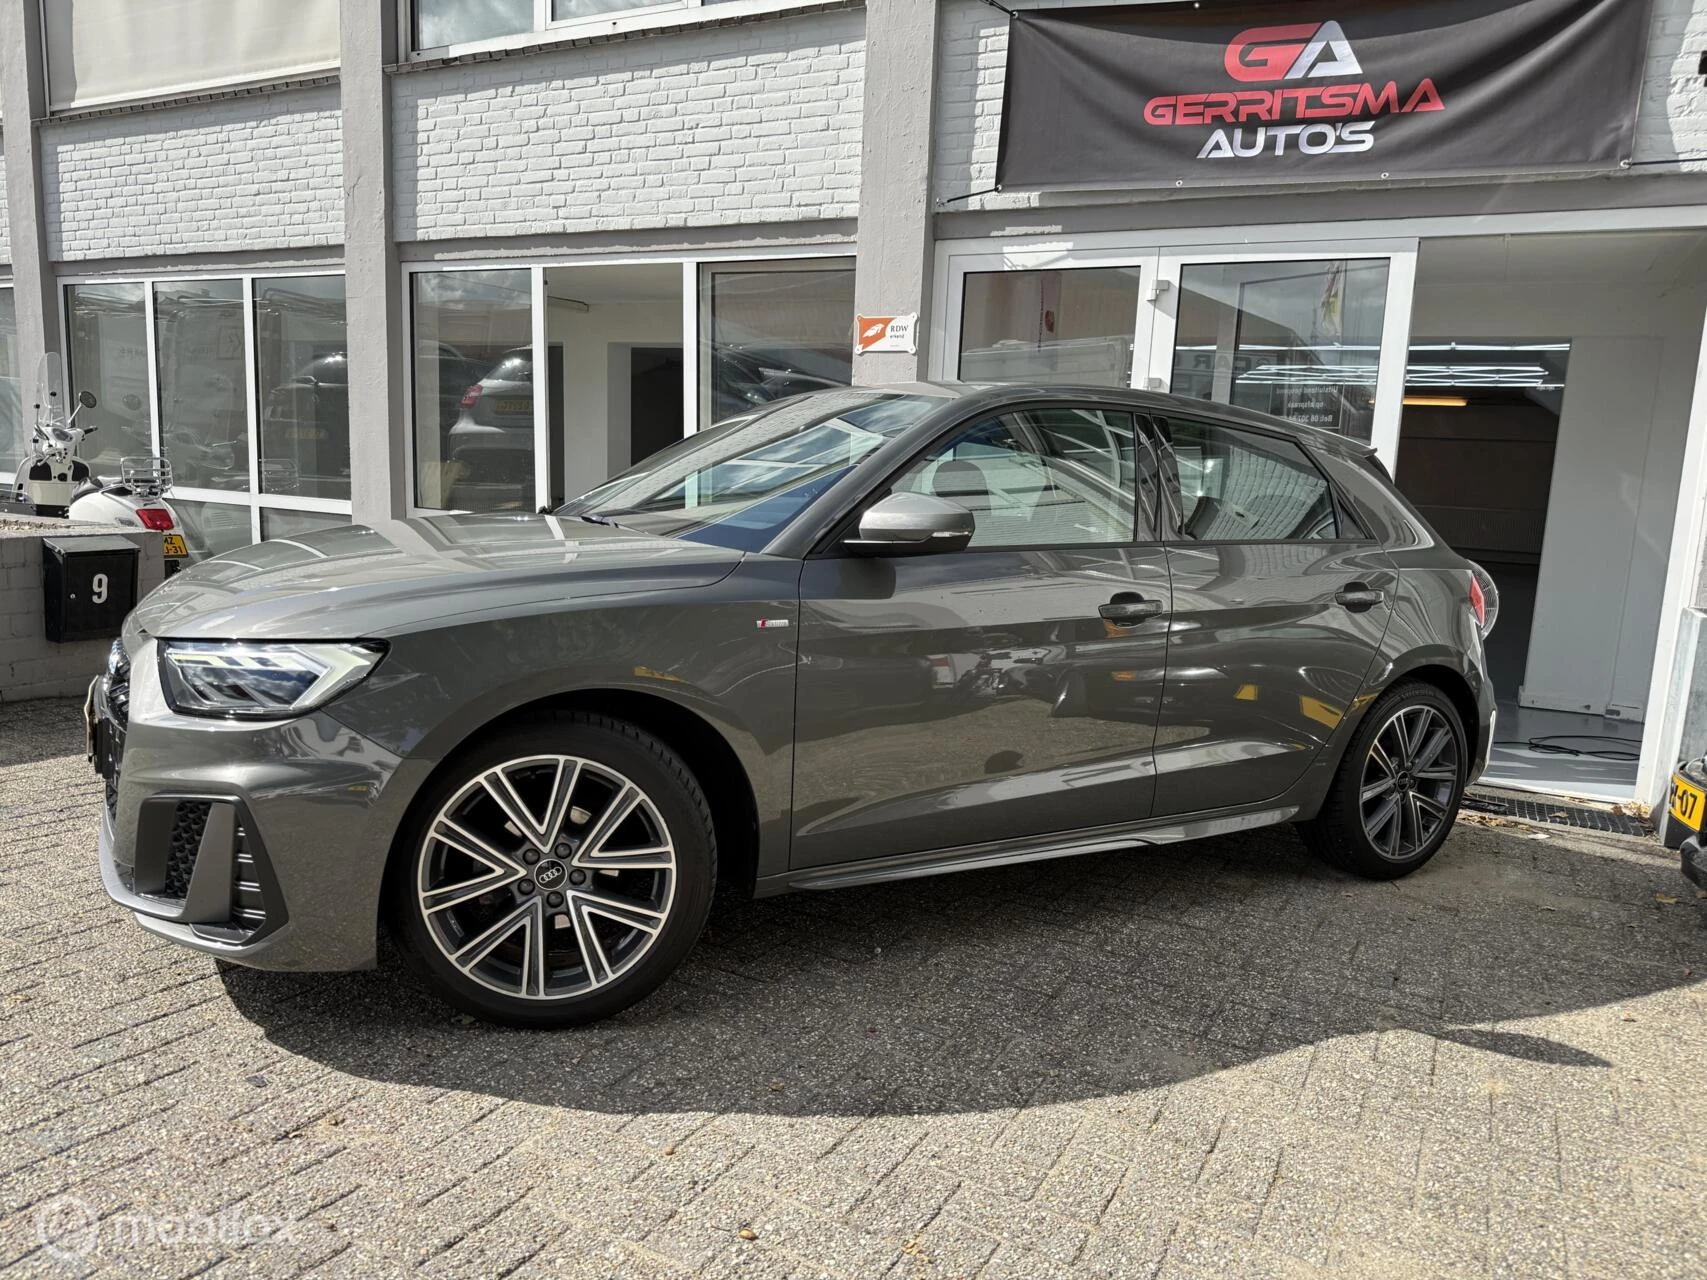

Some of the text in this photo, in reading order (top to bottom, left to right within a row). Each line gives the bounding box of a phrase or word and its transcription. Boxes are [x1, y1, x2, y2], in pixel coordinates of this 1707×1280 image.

[1224, 20, 1363, 82] GA
[1143, 78, 1446, 126] GERRITSMA
[1197, 120, 1375, 159] AUTO'S
[890, 325, 909, 333] RDW
[92, 573, 108, 604] 9
